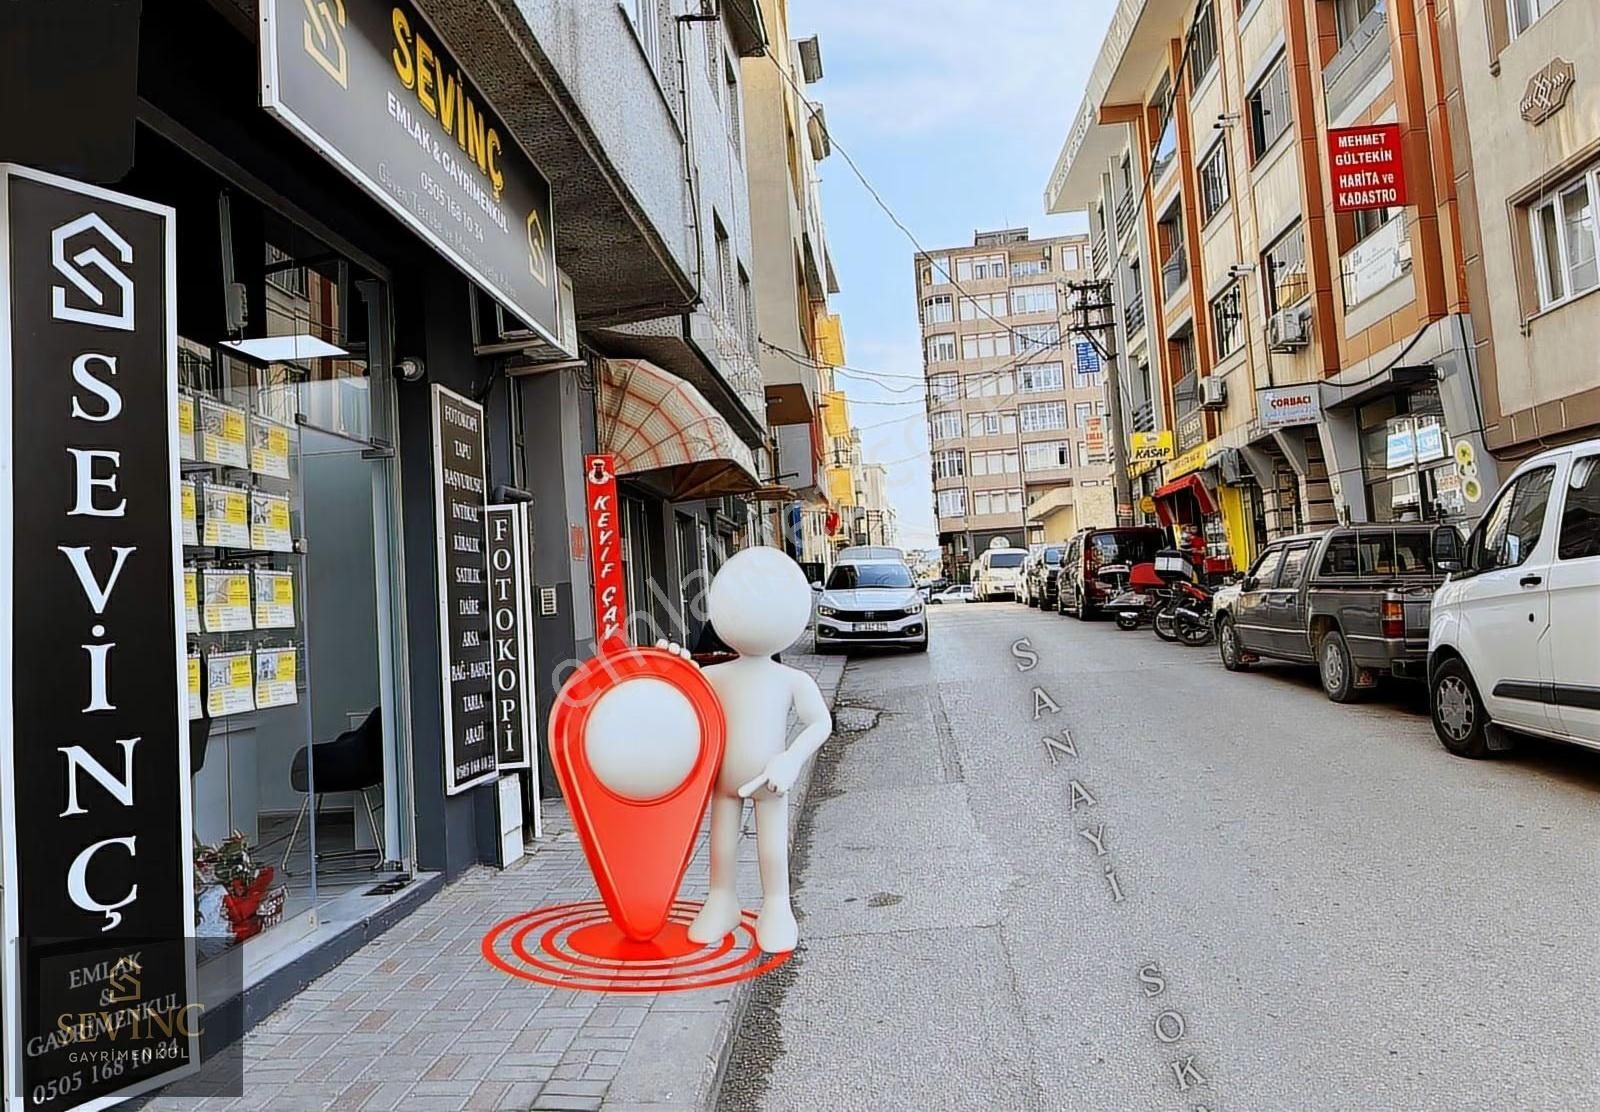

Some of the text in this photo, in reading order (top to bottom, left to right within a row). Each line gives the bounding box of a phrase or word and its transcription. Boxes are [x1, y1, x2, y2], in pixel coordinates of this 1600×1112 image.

[391, 7, 505, 202] SEVİNÇ
[1338, 132, 1386, 148] MEHMET
[387, 90, 432, 153] EMLAK
[432, 141, 442, 164] &
[442, 152, 509, 233] GAYRİMENKUL
[1335, 147, 1393, 166] GÜLTEKİN
[1339, 169, 1394, 188] HARİTA ve
[420, 172, 445, 206] 0505
[446, 197, 462, 222] 168
[463, 211, 473, 233] 10
[1339, 189, 1397, 207] KADASTRO
[1271, 395, 1312, 409] ÇORBACI
[453, 440, 472, 460] TAPU
[1135, 447, 1171, 459] KASAP
[455, 567, 481, 583] SATILIK
[593, 495, 620, 641] KEYİF ÇAY
[459, 596, 480, 615] DAİRE
[57, 352, 142, 932] SEVİNÇ
[462, 631, 480, 648] ARSA
[493, 519, 517, 752] FOTOKOPİ
[463, 693, 485, 713] TARLA
[69, 952, 143, 990] EMLAK
[33, 1070, 83, 1105] 0505
[91, 1056, 125, 1085] 168
